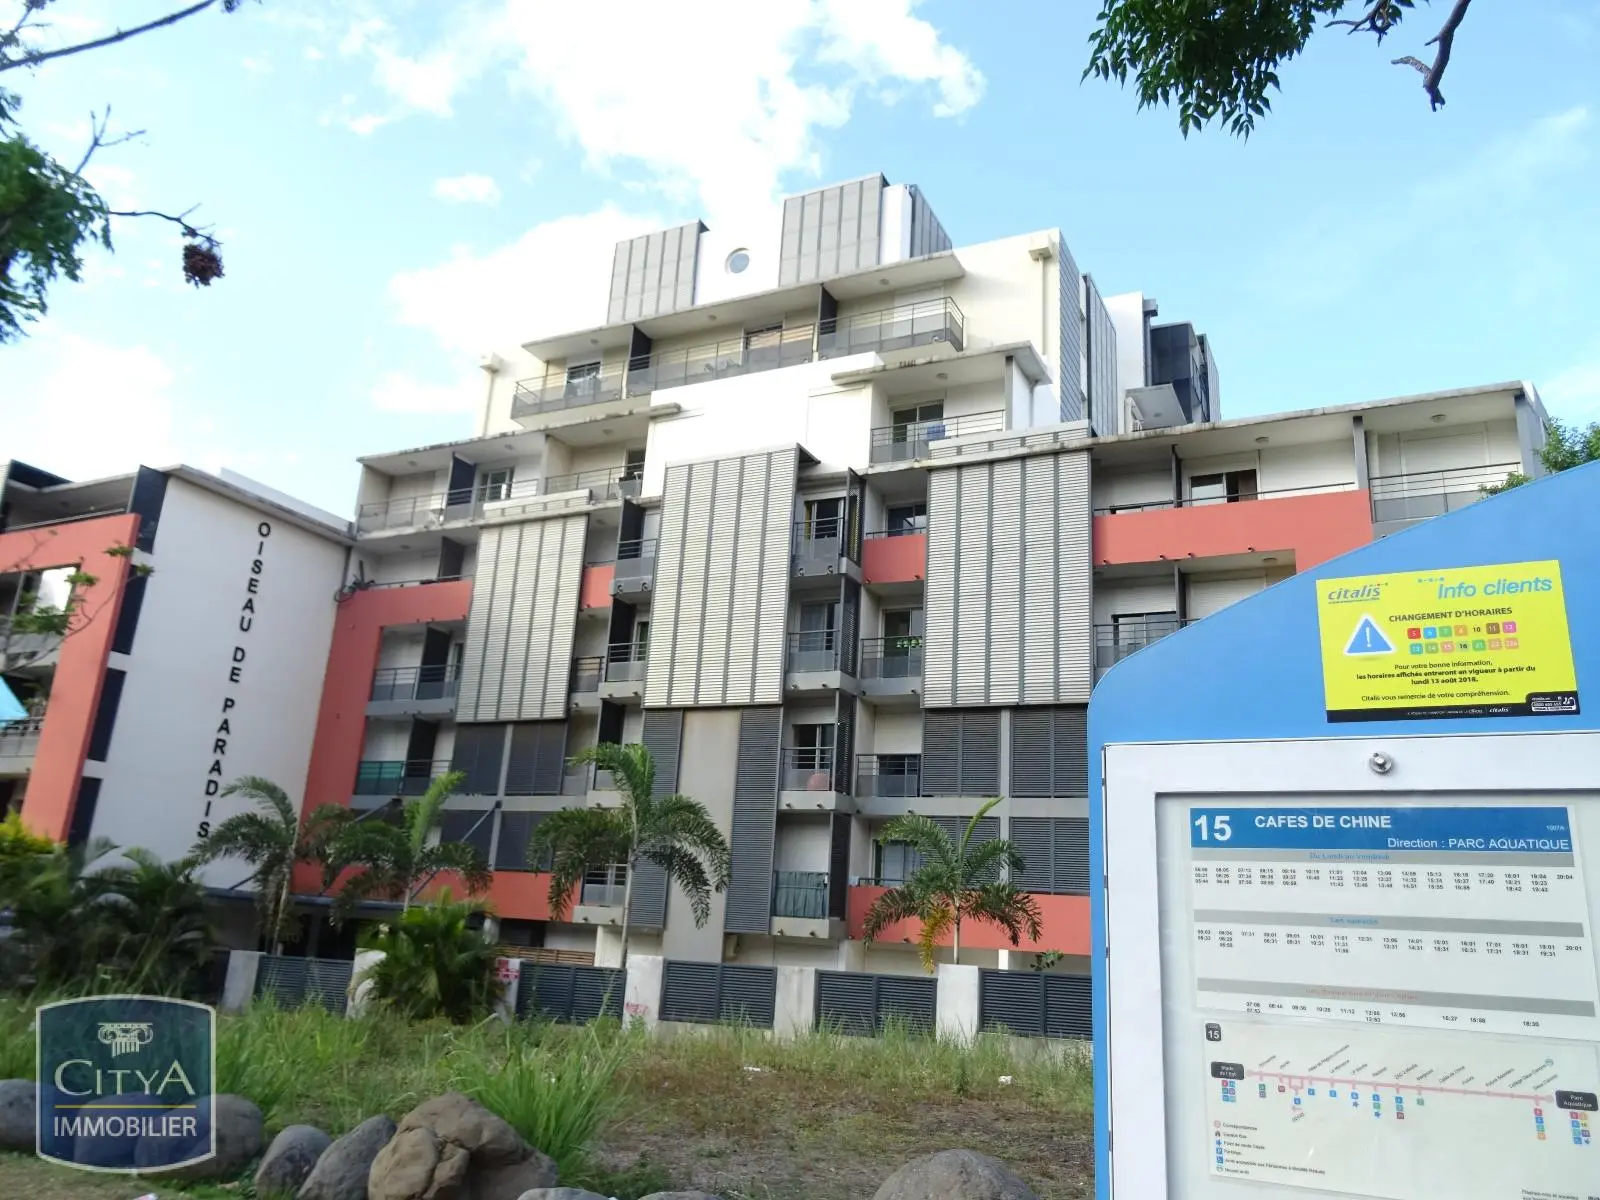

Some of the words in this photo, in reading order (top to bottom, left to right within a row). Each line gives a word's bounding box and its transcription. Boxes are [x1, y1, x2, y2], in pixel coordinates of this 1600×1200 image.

[240, 522, 271, 632] OISEAU
[1328, 585, 1380, 600] citalis
[1438, 582, 1476, 600] Info
[1483, 576, 1552, 596] clients
[1388, 611, 1452, 622] CHANGEMENT
[1455, 607, 1512, 618] D'HORAIRES
[229, 646, 246, 683] DE
[1468, 668, 1496, 676] vigueur
[1504, 666, 1524, 674] partir
[196, 697, 235, 838] PARADIS
[1194, 814, 1232, 841] 15
[1254, 816, 1308, 828] CAFES
[1312, 816, 1334, 828] DE
[1339, 816, 1392, 828] CHINE
[1388, 838, 1438, 848] Direction
[1448, 838, 1485, 849] PARC
[1488, 838, 1569, 850] AQUATIQUE
[1208, 1030, 1220, 1040] 15
